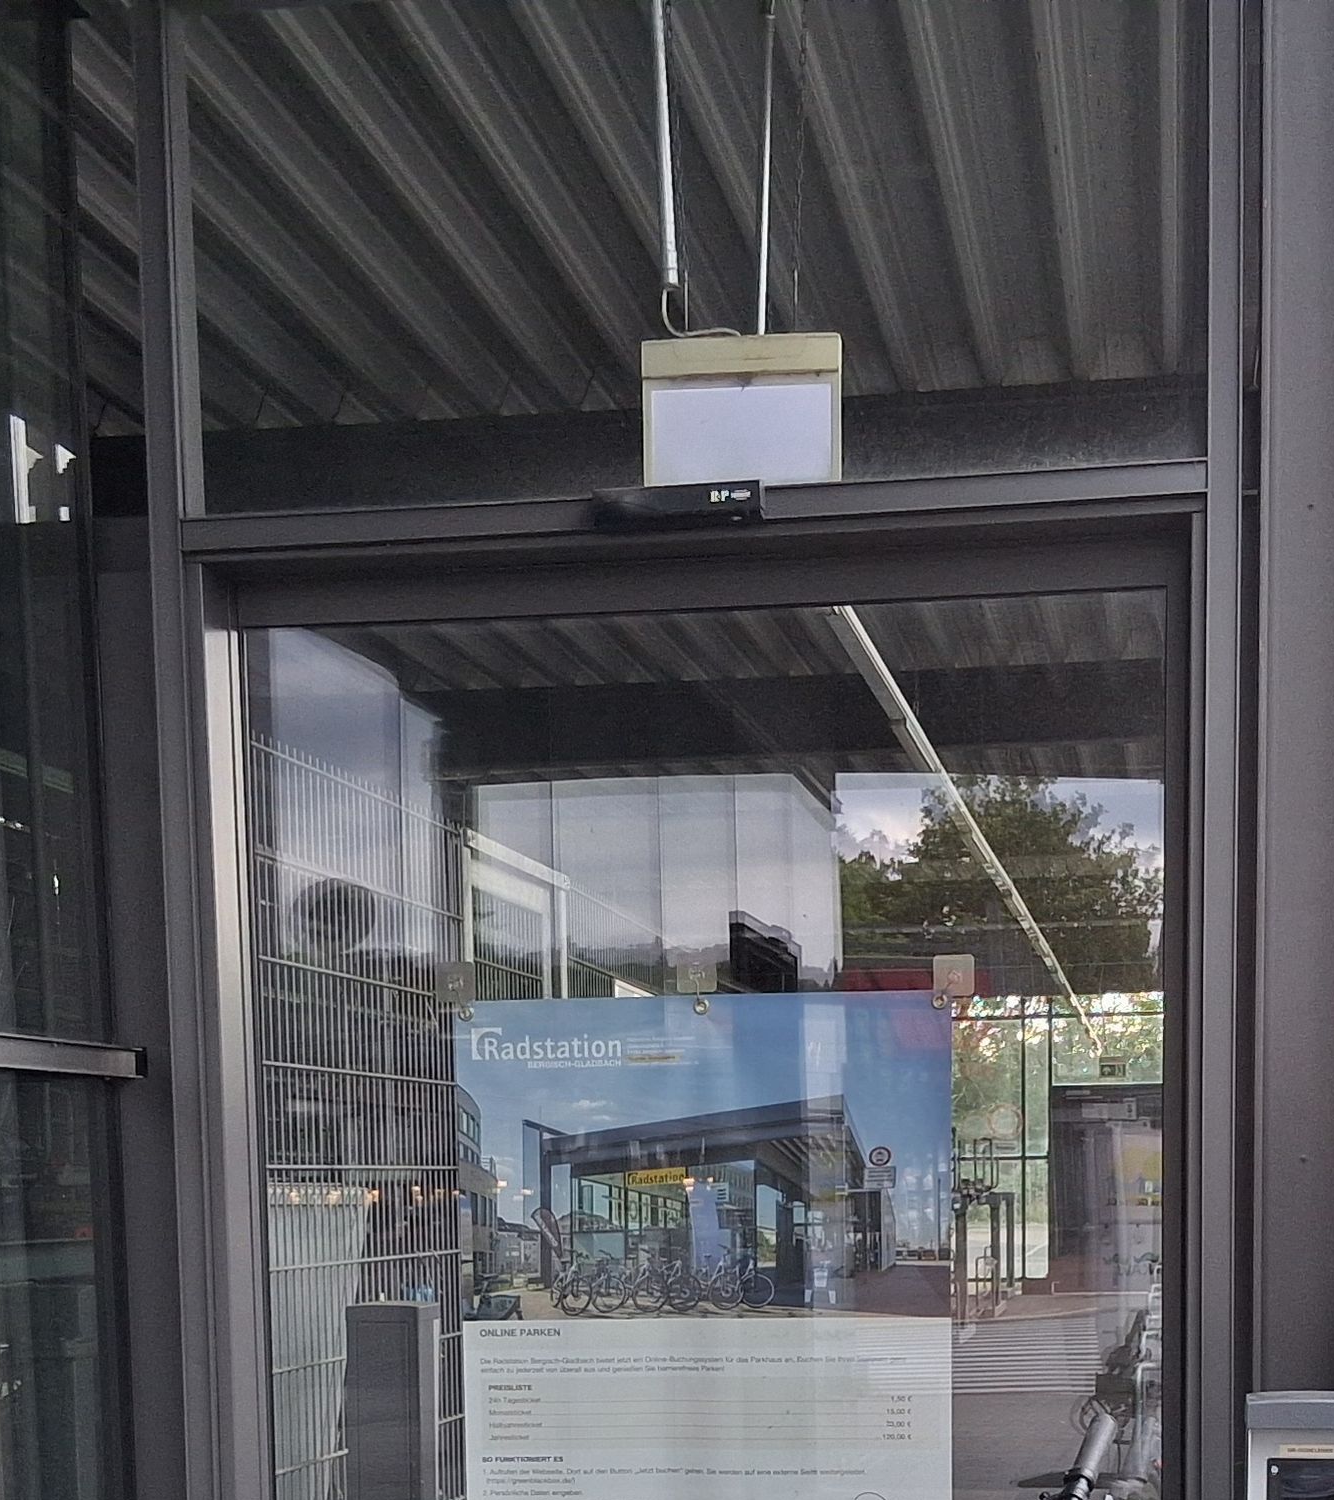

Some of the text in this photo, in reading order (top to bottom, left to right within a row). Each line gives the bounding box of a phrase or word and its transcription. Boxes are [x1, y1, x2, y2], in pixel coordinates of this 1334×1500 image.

[484, 1033, 622, 1060] Radstation
[479, 1328, 561, 1338] ONLINE PARKEN
